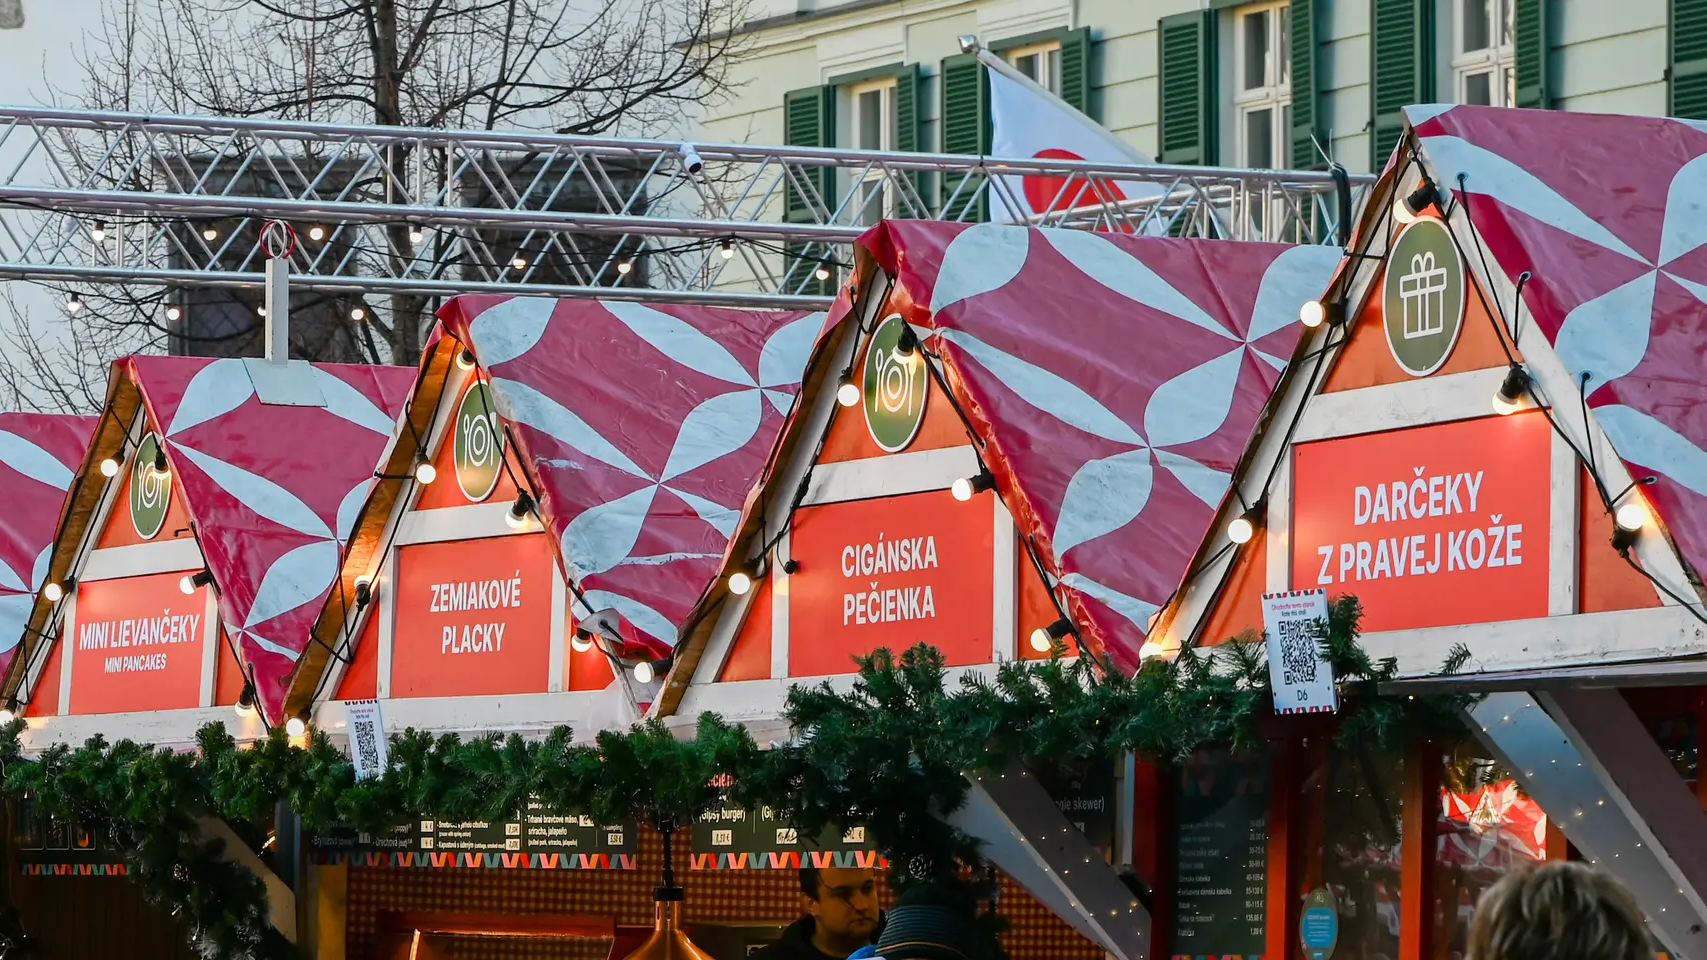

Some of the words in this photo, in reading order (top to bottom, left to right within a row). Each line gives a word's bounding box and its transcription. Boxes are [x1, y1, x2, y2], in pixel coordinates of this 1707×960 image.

[1355, 466, 1483, 525] DARČEKY
[842, 531, 938, 578] CIGÁNSKA
[1318, 545, 1333, 584] Z
[1340, 533, 1440, 582] PRAVEJ
[1447, 513, 1522, 572] KOŽE
[431, 570, 520, 612] ZEMIAKOVÉ
[844, 582, 935, 625] PEČIENKA
[80, 622, 109, 650] MINI
[111, 609, 200, 647] LIEVANČEKY
[442, 623, 505, 653] PLACKY
[105, 657, 122, 672] MINI
[123, 653, 166, 671] PANCAKES
[1297, 690, 1308, 701] D6
[722, 807, 746, 823] burger)
